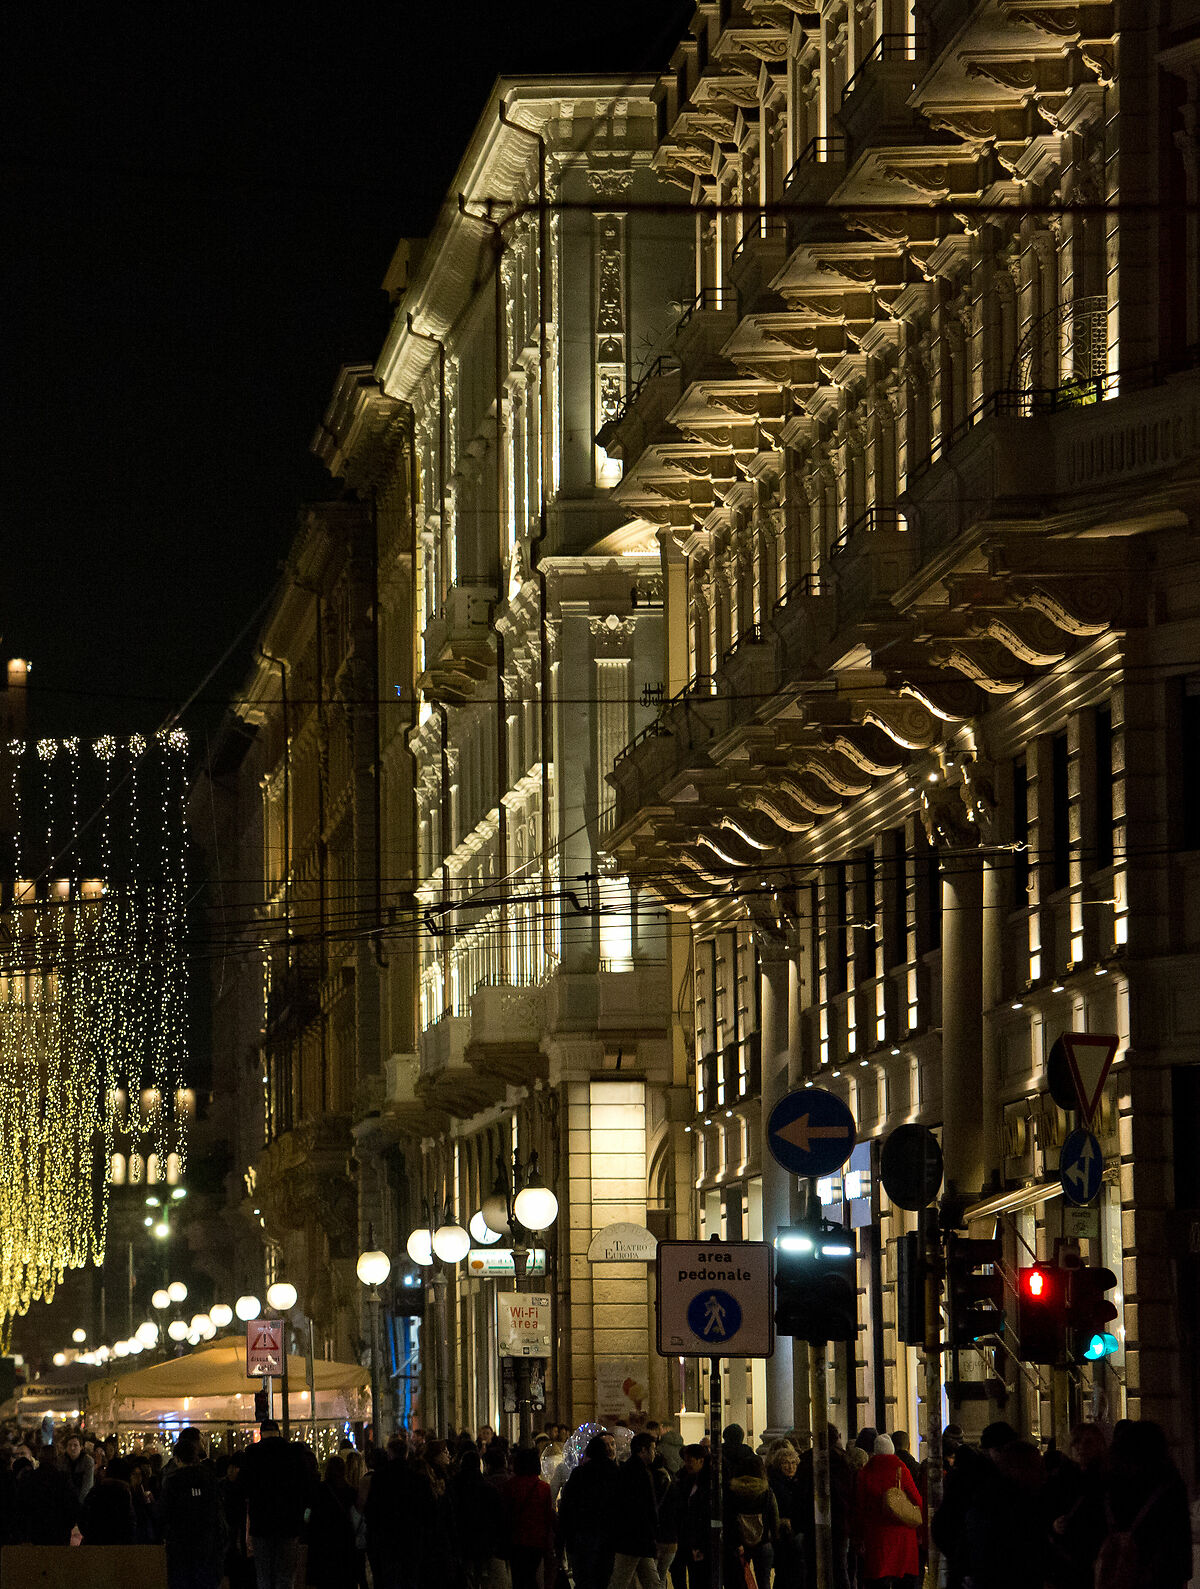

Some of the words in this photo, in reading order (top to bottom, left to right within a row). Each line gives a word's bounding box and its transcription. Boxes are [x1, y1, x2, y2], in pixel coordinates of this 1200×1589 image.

[698, 1253, 732, 1263] area
[678, 1268, 751, 1282] pedonale
[510, 1306, 538, 1318] Wi-Fi
[510, 1320, 538, 1329] area
